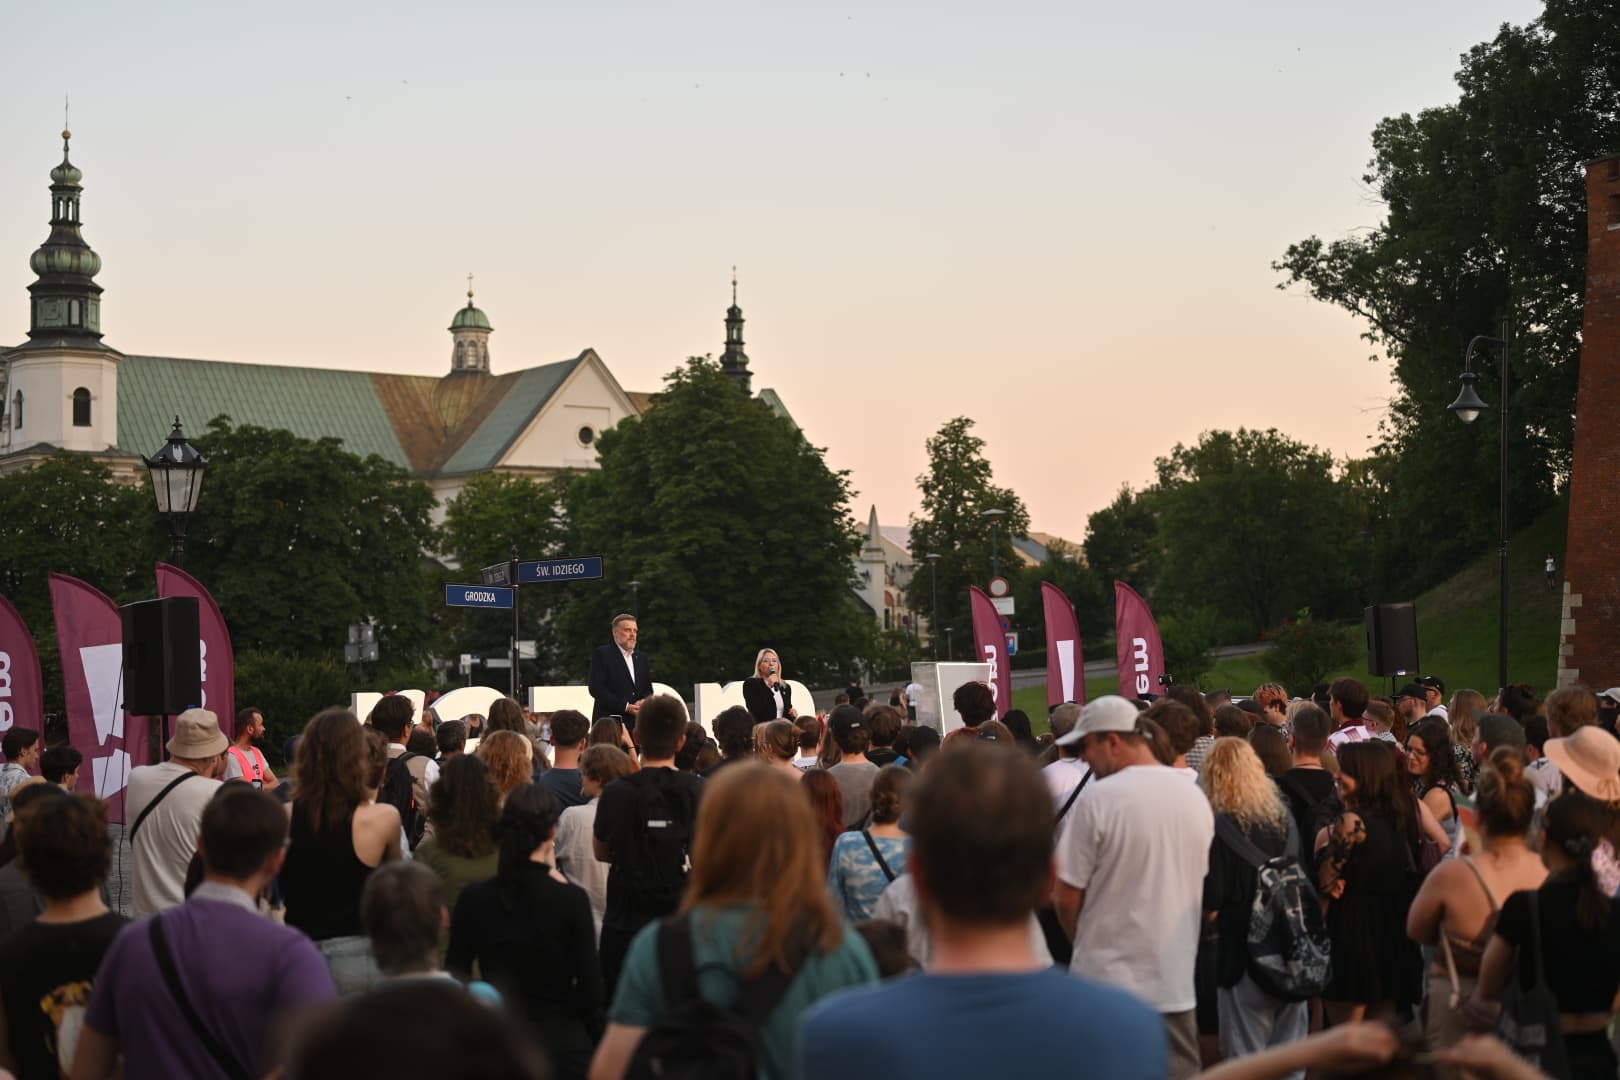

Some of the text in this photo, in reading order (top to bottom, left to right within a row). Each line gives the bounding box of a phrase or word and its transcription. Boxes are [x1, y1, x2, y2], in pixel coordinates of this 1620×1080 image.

[536, 563, 585, 577] ŚW. IDZIEGO
[465, 591, 496, 603] GRODZKA
